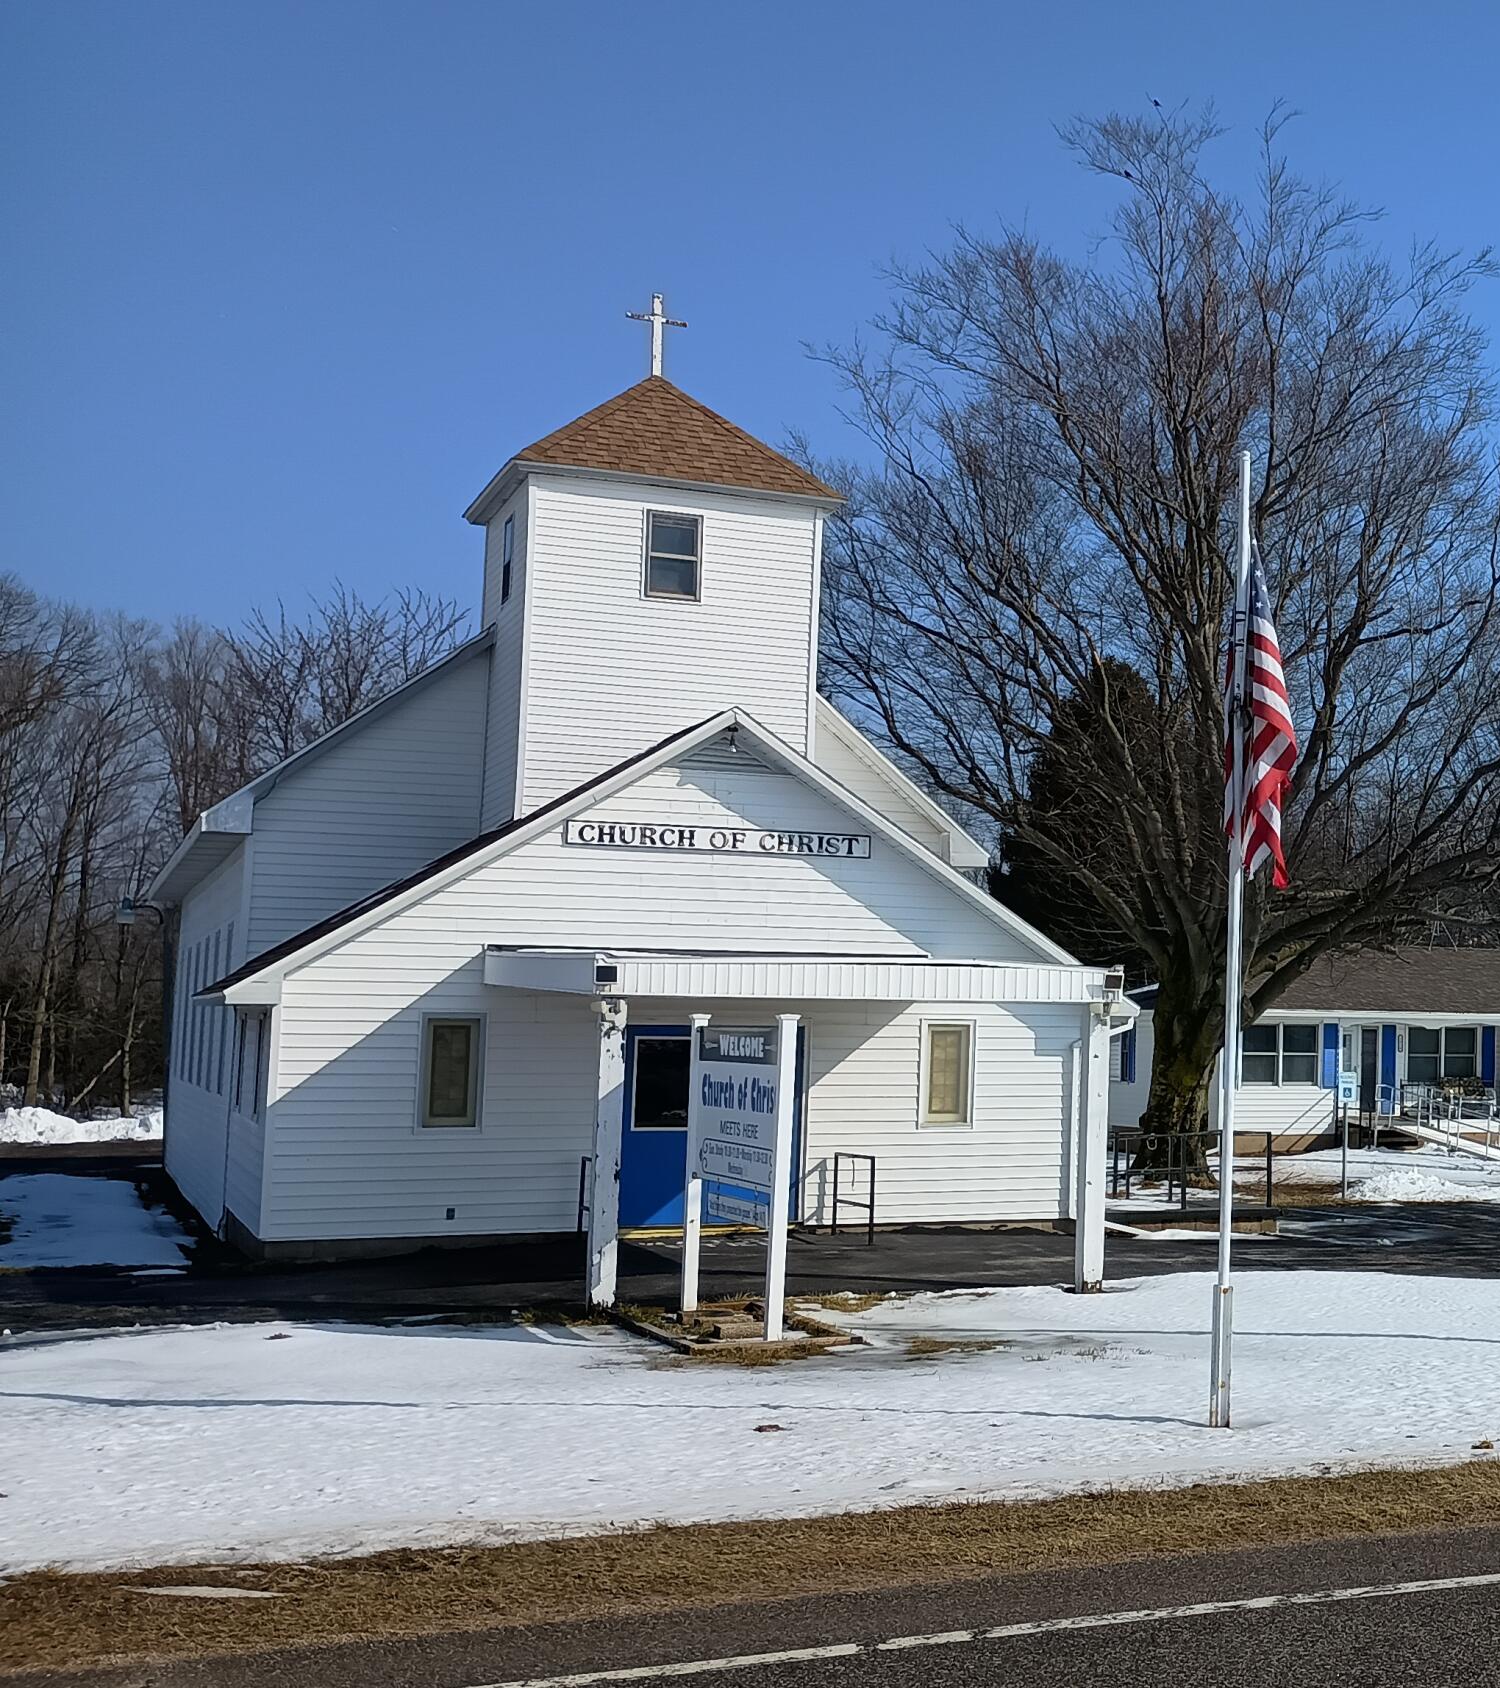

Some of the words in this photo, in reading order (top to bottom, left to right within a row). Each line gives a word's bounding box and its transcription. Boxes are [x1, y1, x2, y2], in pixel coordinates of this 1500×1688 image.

[578, 823, 696, 848] CHURCH
[709, 830, 747, 850] OF
[758, 833, 860, 856] CHRIST
[719, 1034, 765, 1058] WELCOME
[701, 1073, 735, 1110] Church
[738, 1076, 749, 1111] of
[750, 1076, 777, 1115] Chris
[719, 1120, 741, 1137] MEETS
[742, 1123, 759, 1139] HERE
